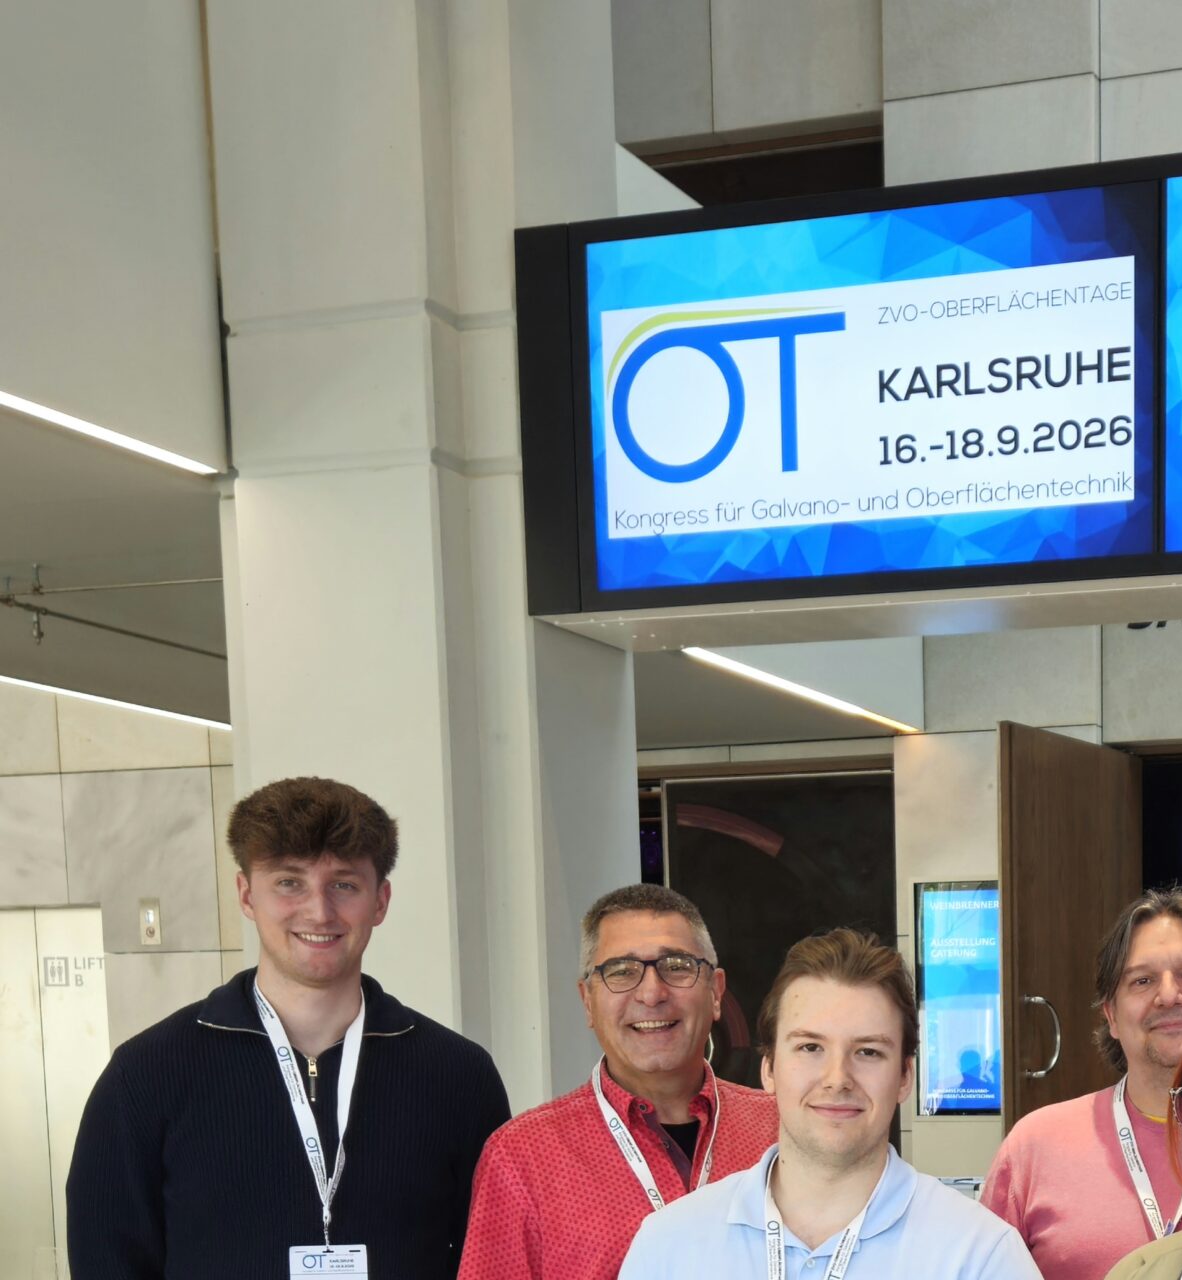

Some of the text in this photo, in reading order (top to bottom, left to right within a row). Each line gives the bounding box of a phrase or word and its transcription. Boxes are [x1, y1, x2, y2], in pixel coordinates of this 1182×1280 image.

[877, 281, 1133, 325] ZVO-OBERFLÄCHENTAGE
[878, 345, 1132, 403] KARLSRUHE
[612, 311, 847, 483] OT
[879, 415, 1133, 466] 16.-18.9.2026
[614, 471, 1133, 535] Kongress für Galvano- und Oberflächentechnik
[74, 957, 105, 970] LIFT
[930, 937, 996, 947] AUSSTELLUNG
[75, 974, 84, 987] B
[303, 1254, 327, 1269] OT
